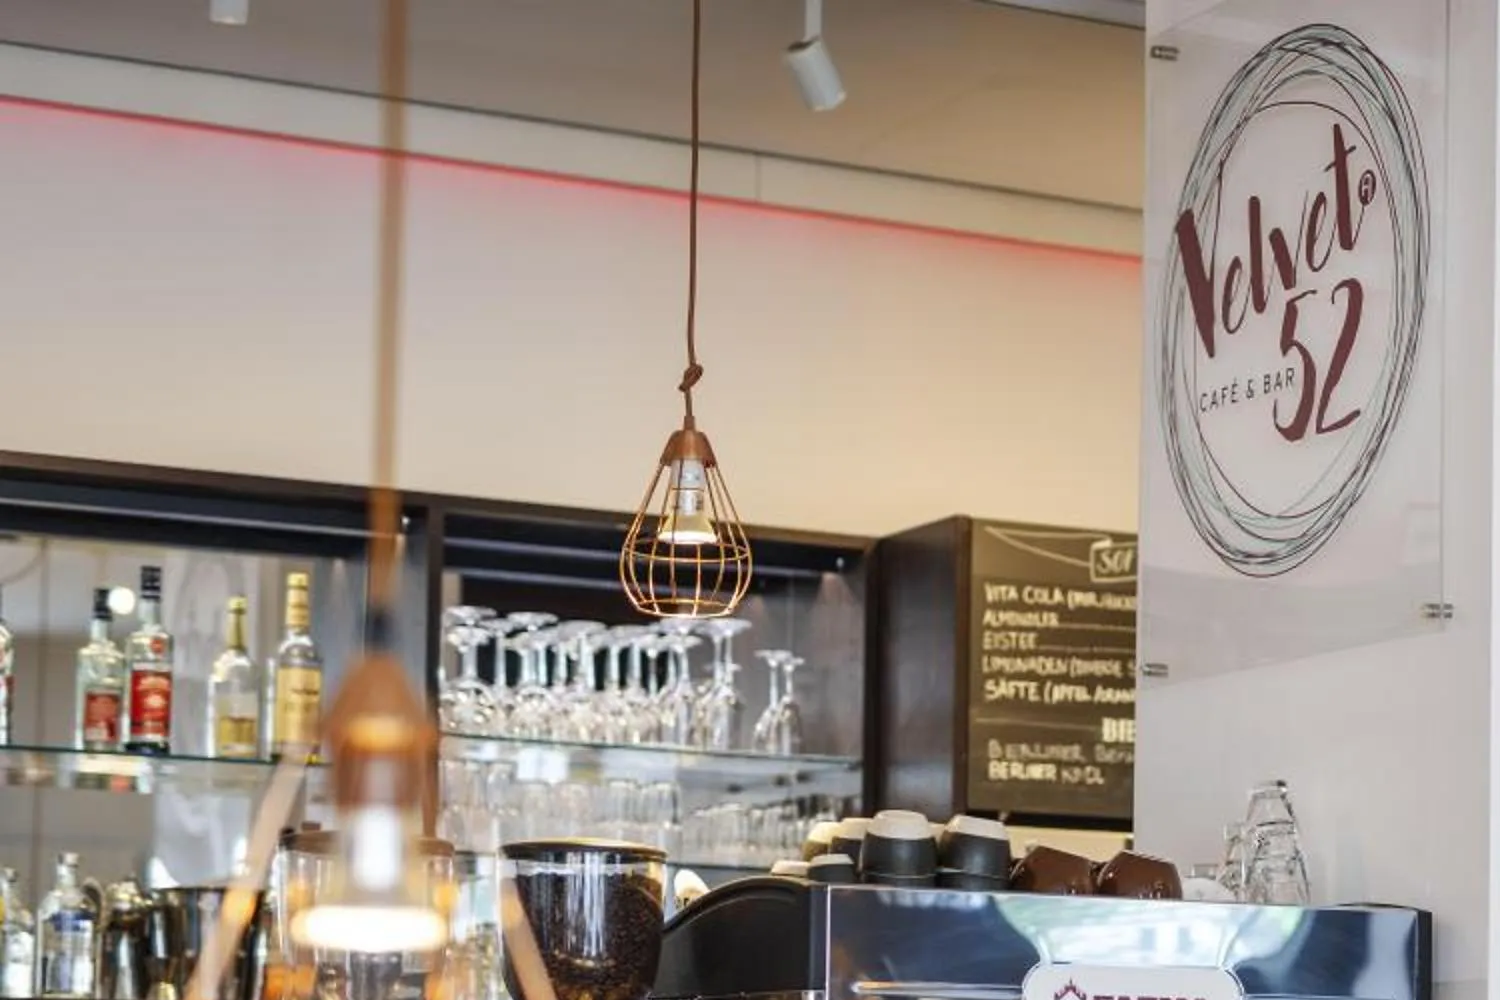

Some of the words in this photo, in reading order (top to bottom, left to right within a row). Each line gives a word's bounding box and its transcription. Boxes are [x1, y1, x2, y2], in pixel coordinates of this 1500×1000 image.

[1175, 123, 1358, 358] Velvet
[1200, 377, 1239, 413] CAFÉ
[1246, 379, 1255, 399] &
[1263, 367, 1295, 394] BAR
[1273, 278, 1362, 442] 52
